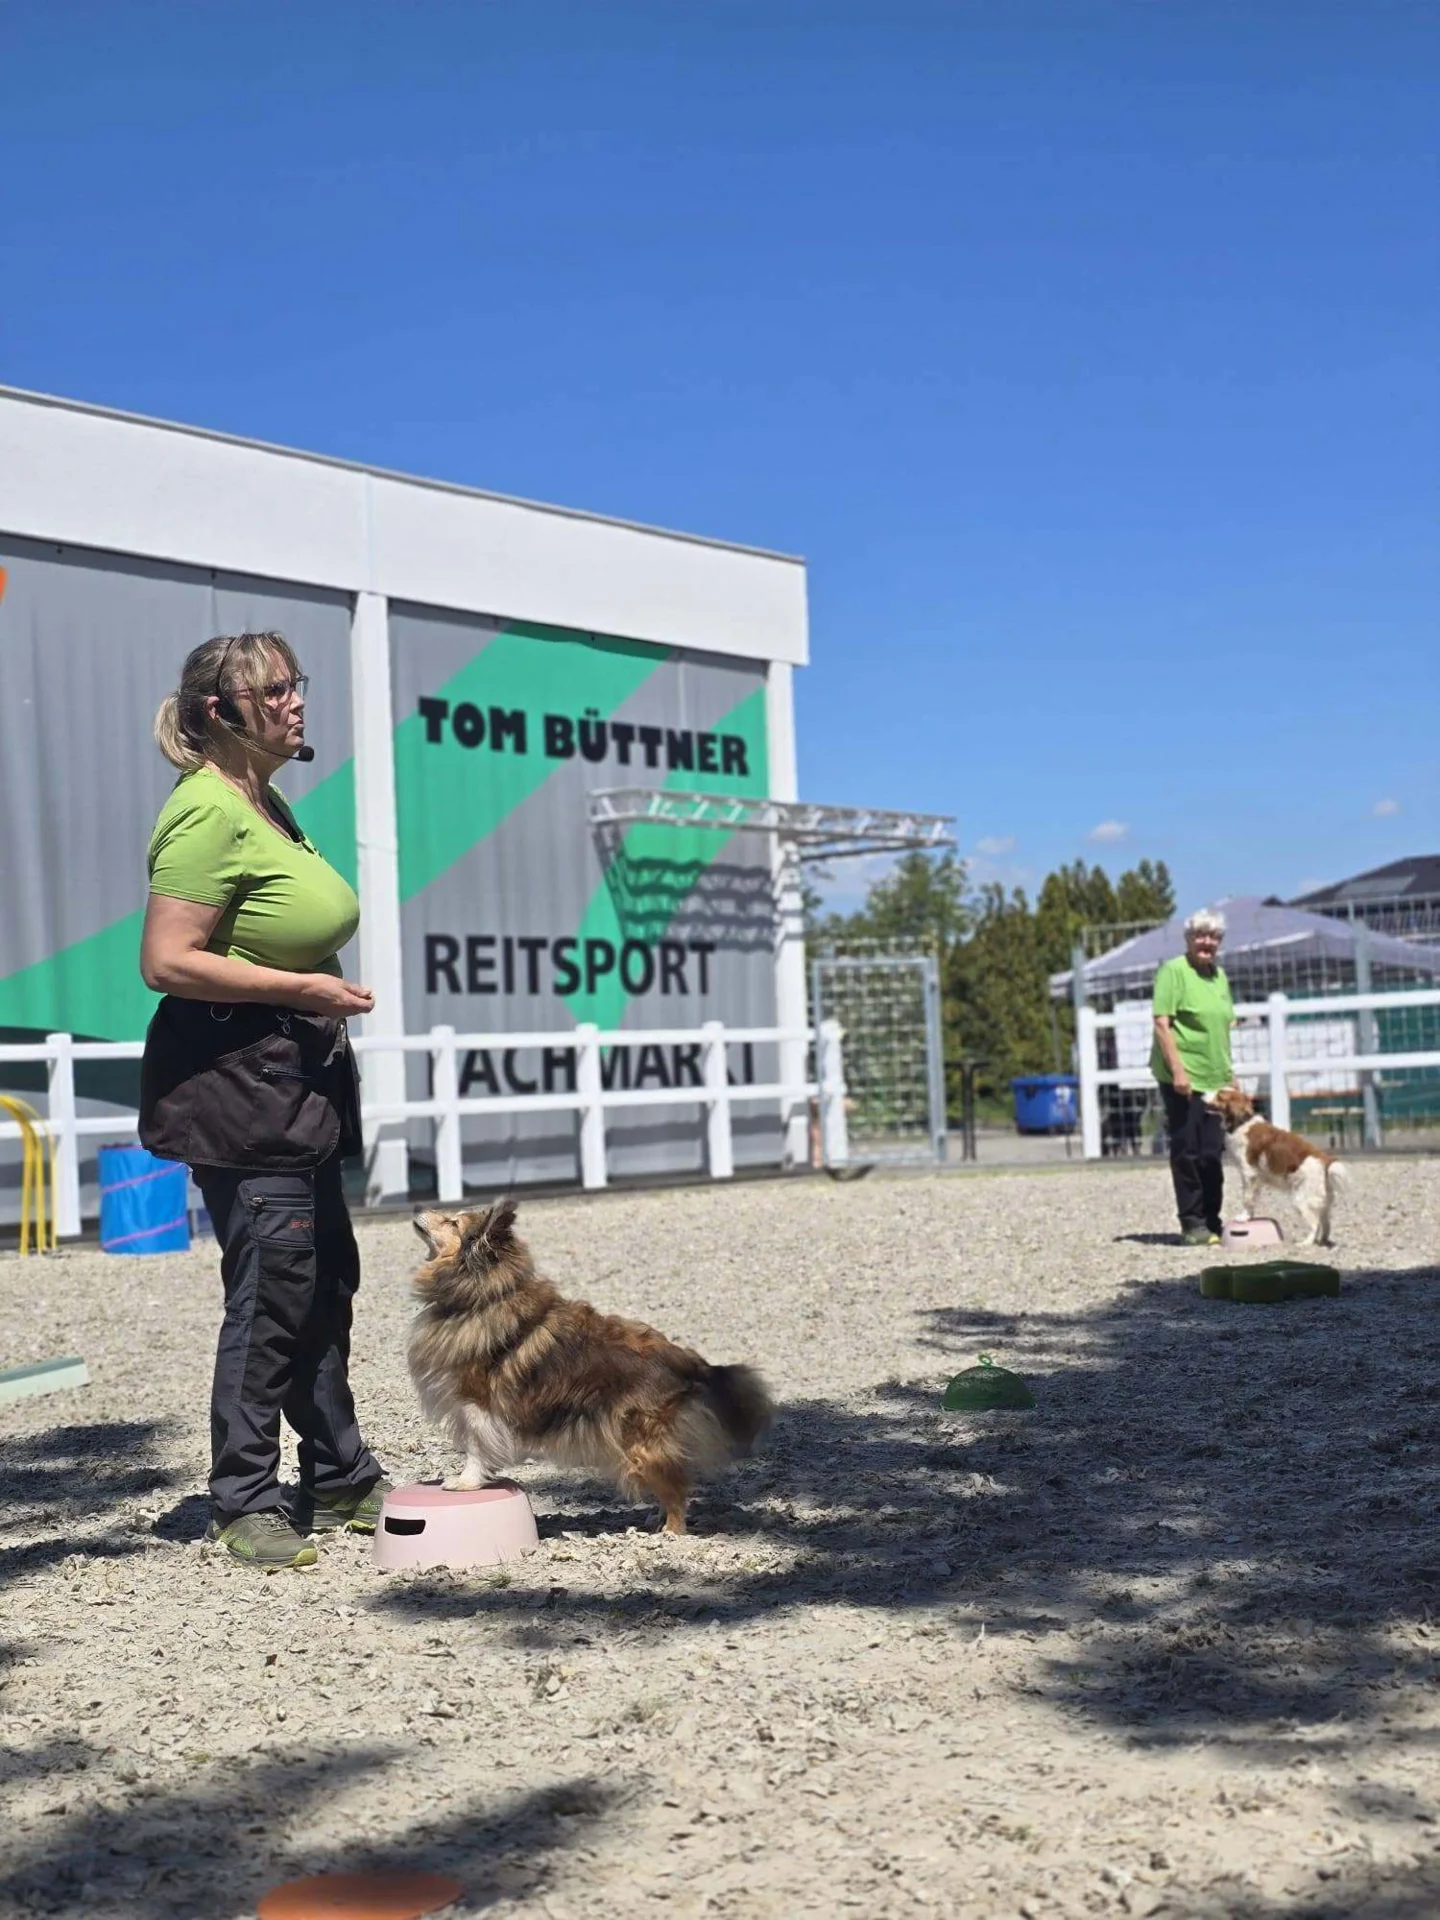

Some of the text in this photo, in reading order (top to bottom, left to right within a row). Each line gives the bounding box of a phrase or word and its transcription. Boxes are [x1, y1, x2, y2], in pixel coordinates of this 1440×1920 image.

[418, 696, 749, 777] TOM BÜTTNER
[425, 934, 716, 996] REITSPORT
